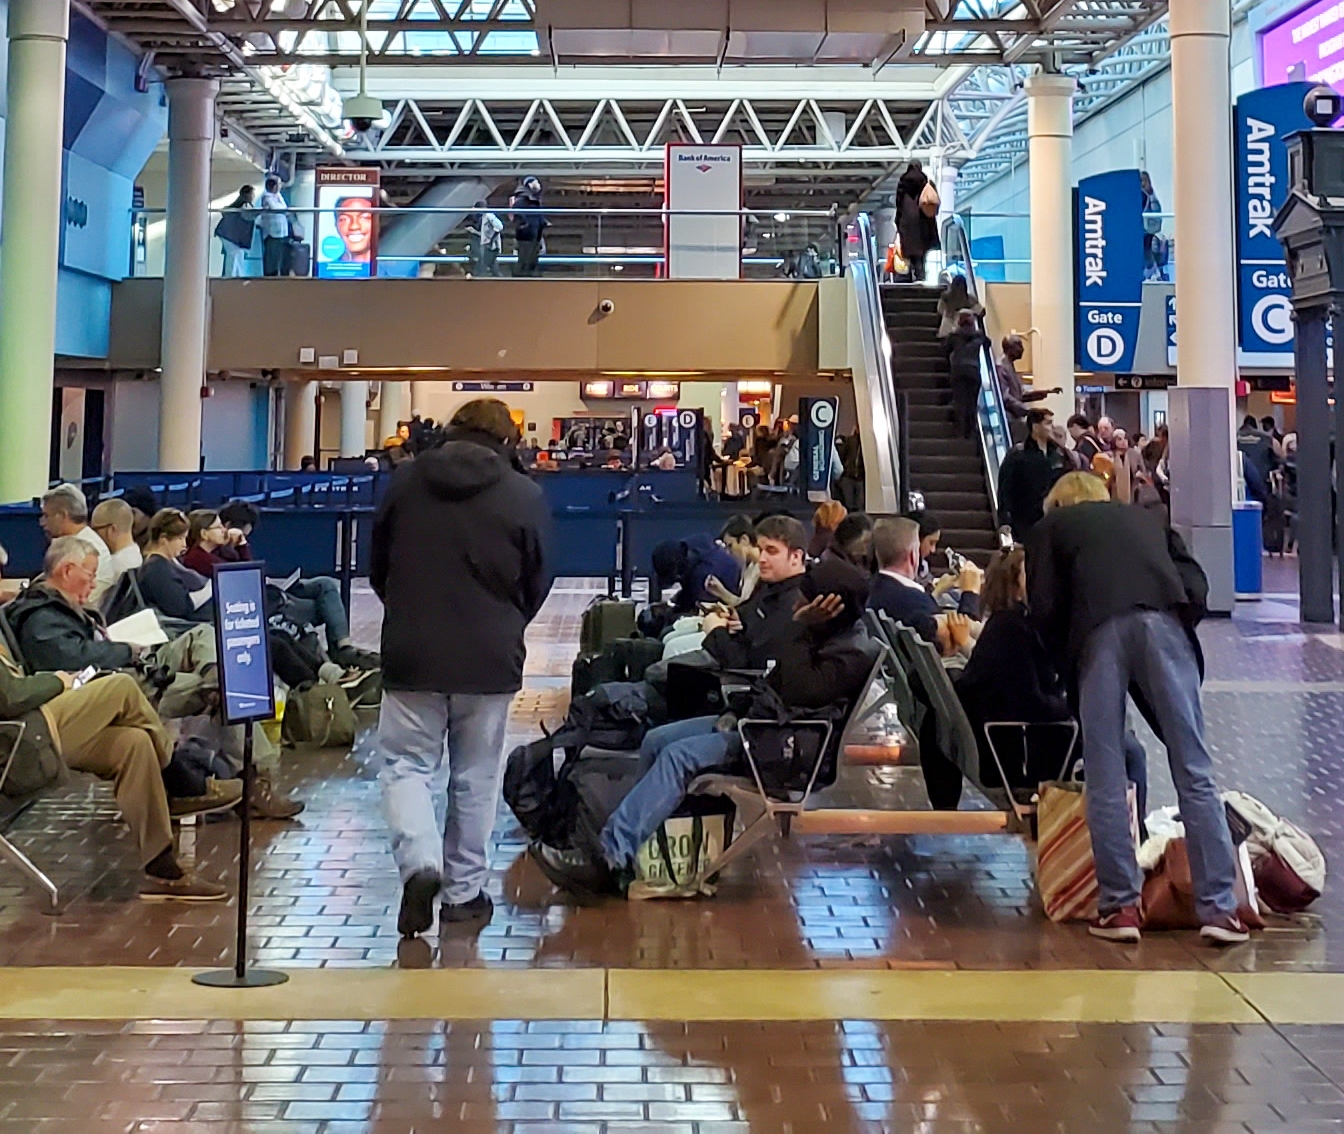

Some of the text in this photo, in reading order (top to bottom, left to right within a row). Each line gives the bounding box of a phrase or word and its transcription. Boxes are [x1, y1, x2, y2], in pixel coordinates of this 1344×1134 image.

[1246, 117, 1275, 239] Amtrak
[1084, 195, 1107, 287] Amtrak
[1087, 310, 1123, 324] Gate
[1261, 303, 1286, 334] C
[1096, 334, 1117, 358] D
